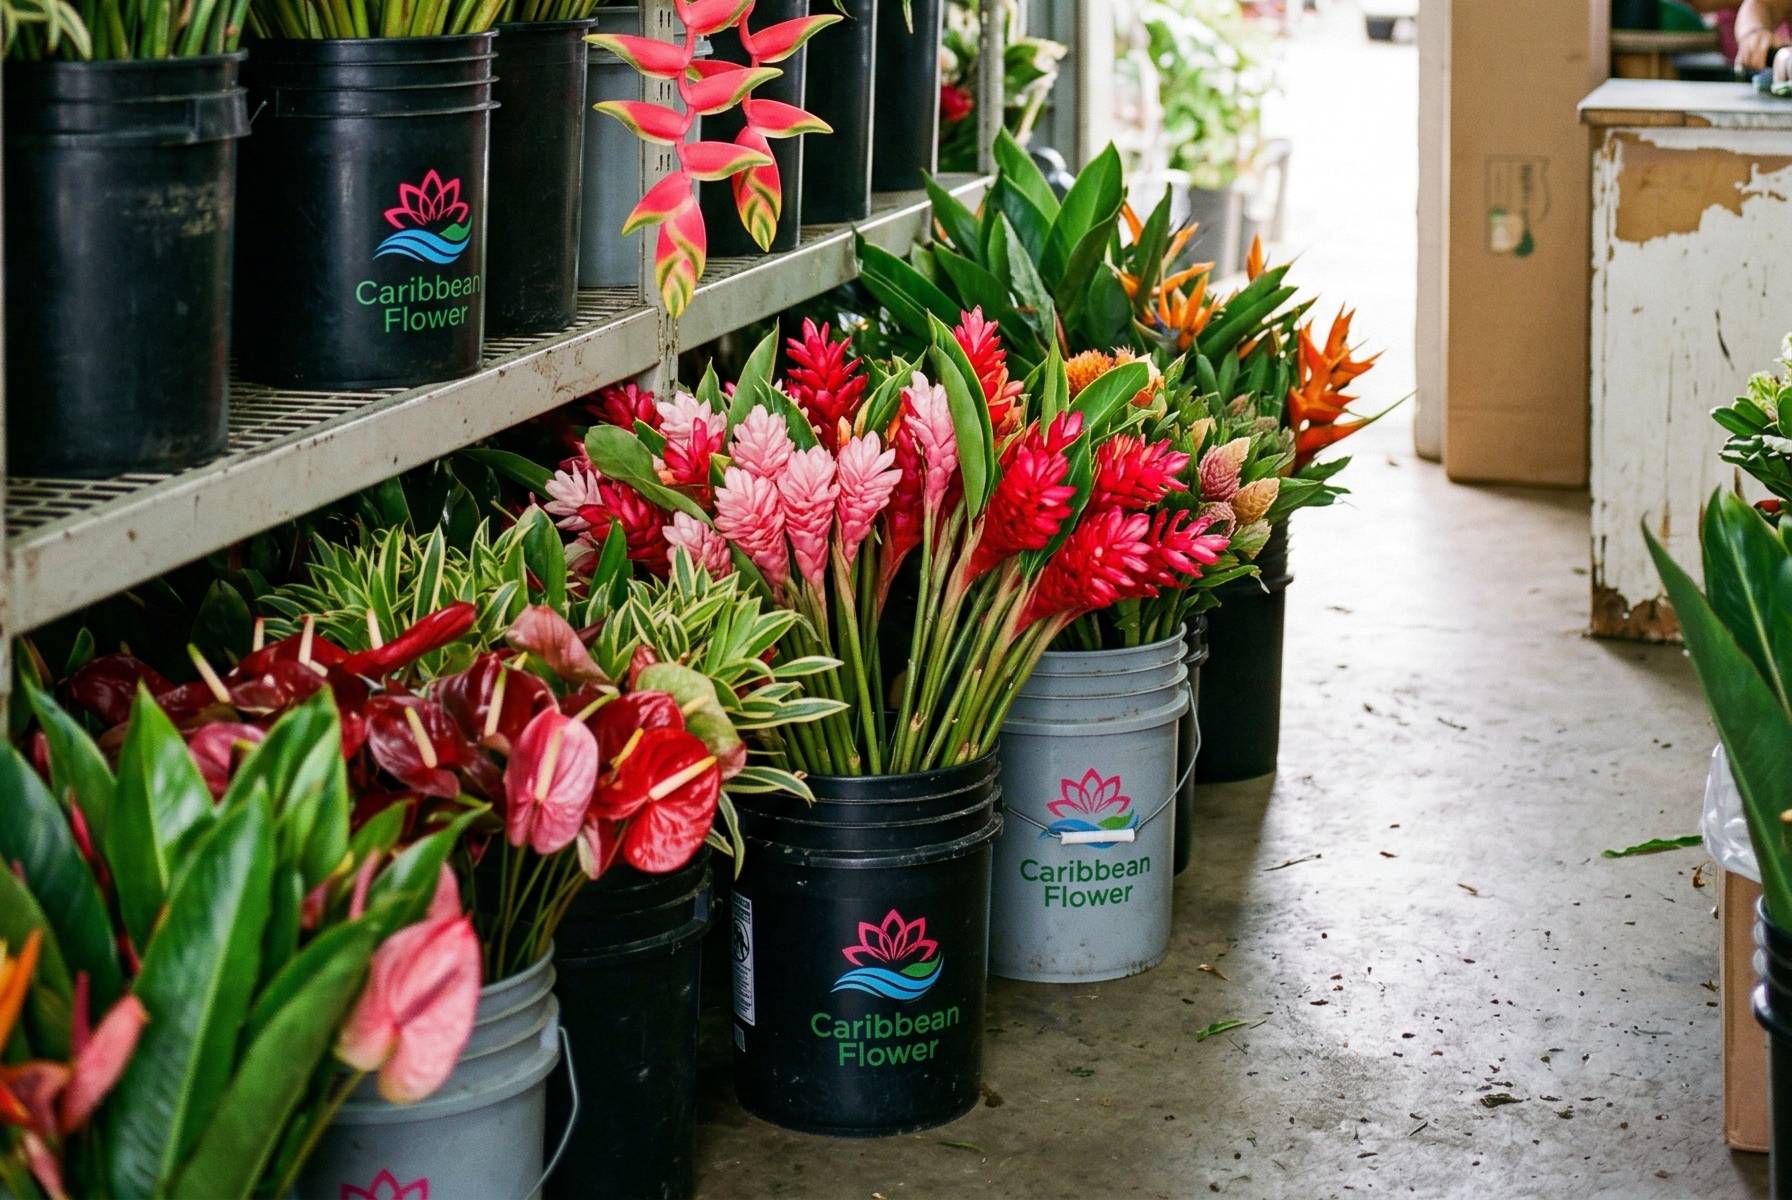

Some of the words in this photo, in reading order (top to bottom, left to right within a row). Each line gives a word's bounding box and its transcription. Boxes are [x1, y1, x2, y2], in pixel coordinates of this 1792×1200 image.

[355, 274, 481, 306] Caribbean
[385, 305, 469, 333] Flower
[1019, 855, 1151, 883] Caribbean
[1044, 884, 1134, 908] Flower
[810, 1005, 960, 1039] Caribbean
[838, 1038, 940, 1068] Flower
